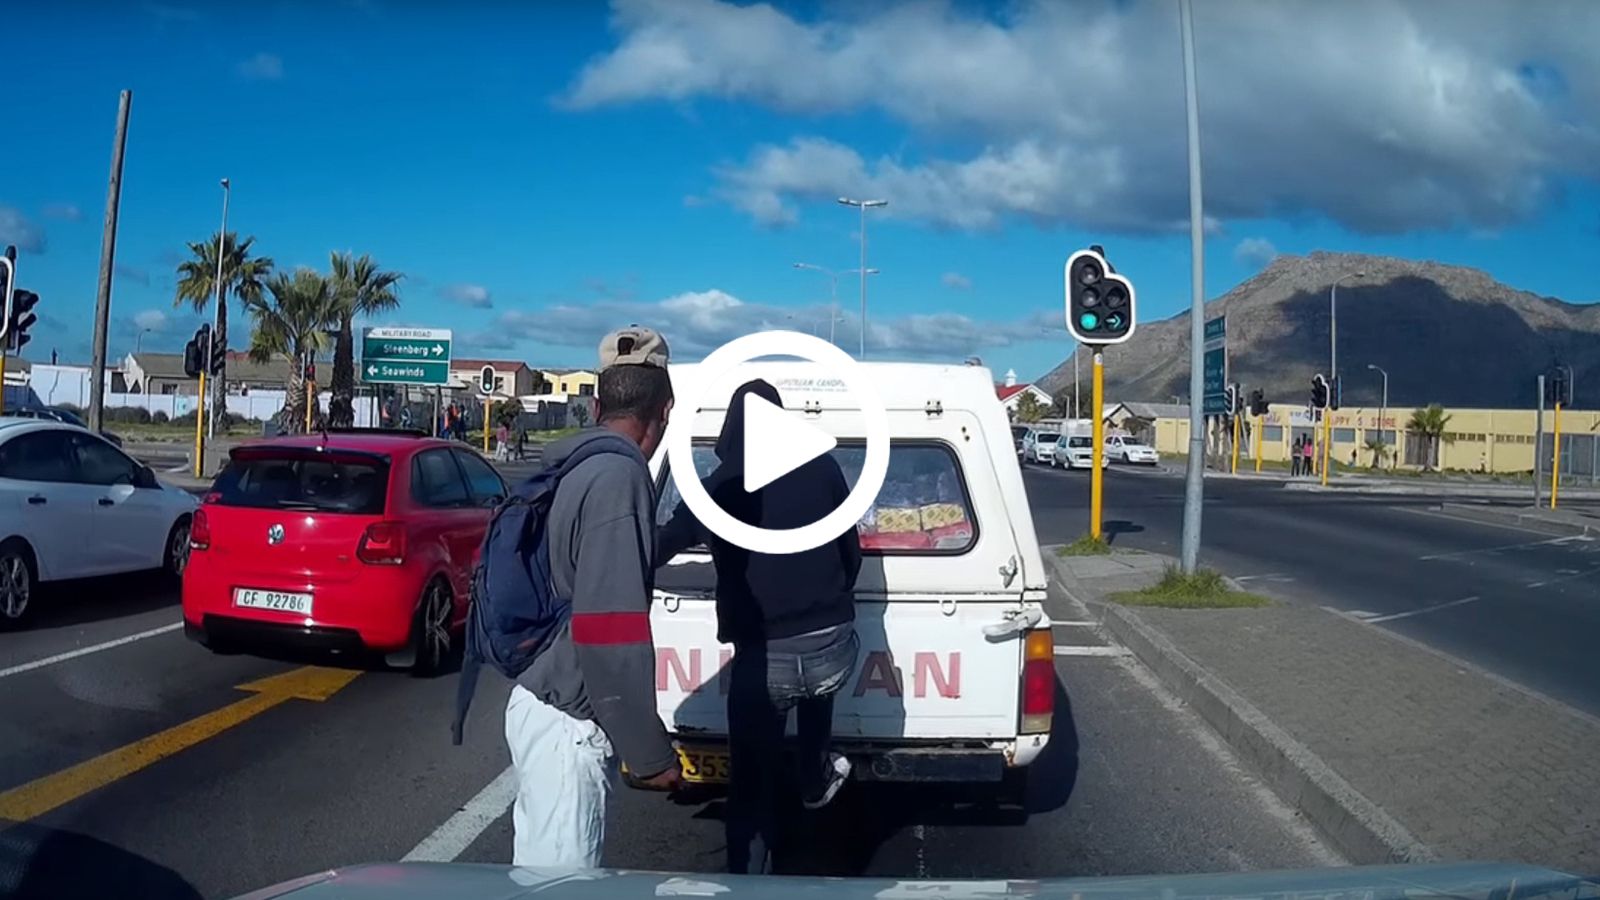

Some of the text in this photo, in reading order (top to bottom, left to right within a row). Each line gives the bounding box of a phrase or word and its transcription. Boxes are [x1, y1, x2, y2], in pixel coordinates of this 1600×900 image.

[413, 330, 432, 338] ROAD
[383, 344, 429, 357] Steenberg
[381, 366, 425, 377] Seawinds
[243, 592, 305, 611] CF 92786
[656, 647, 961, 699] NIAN
